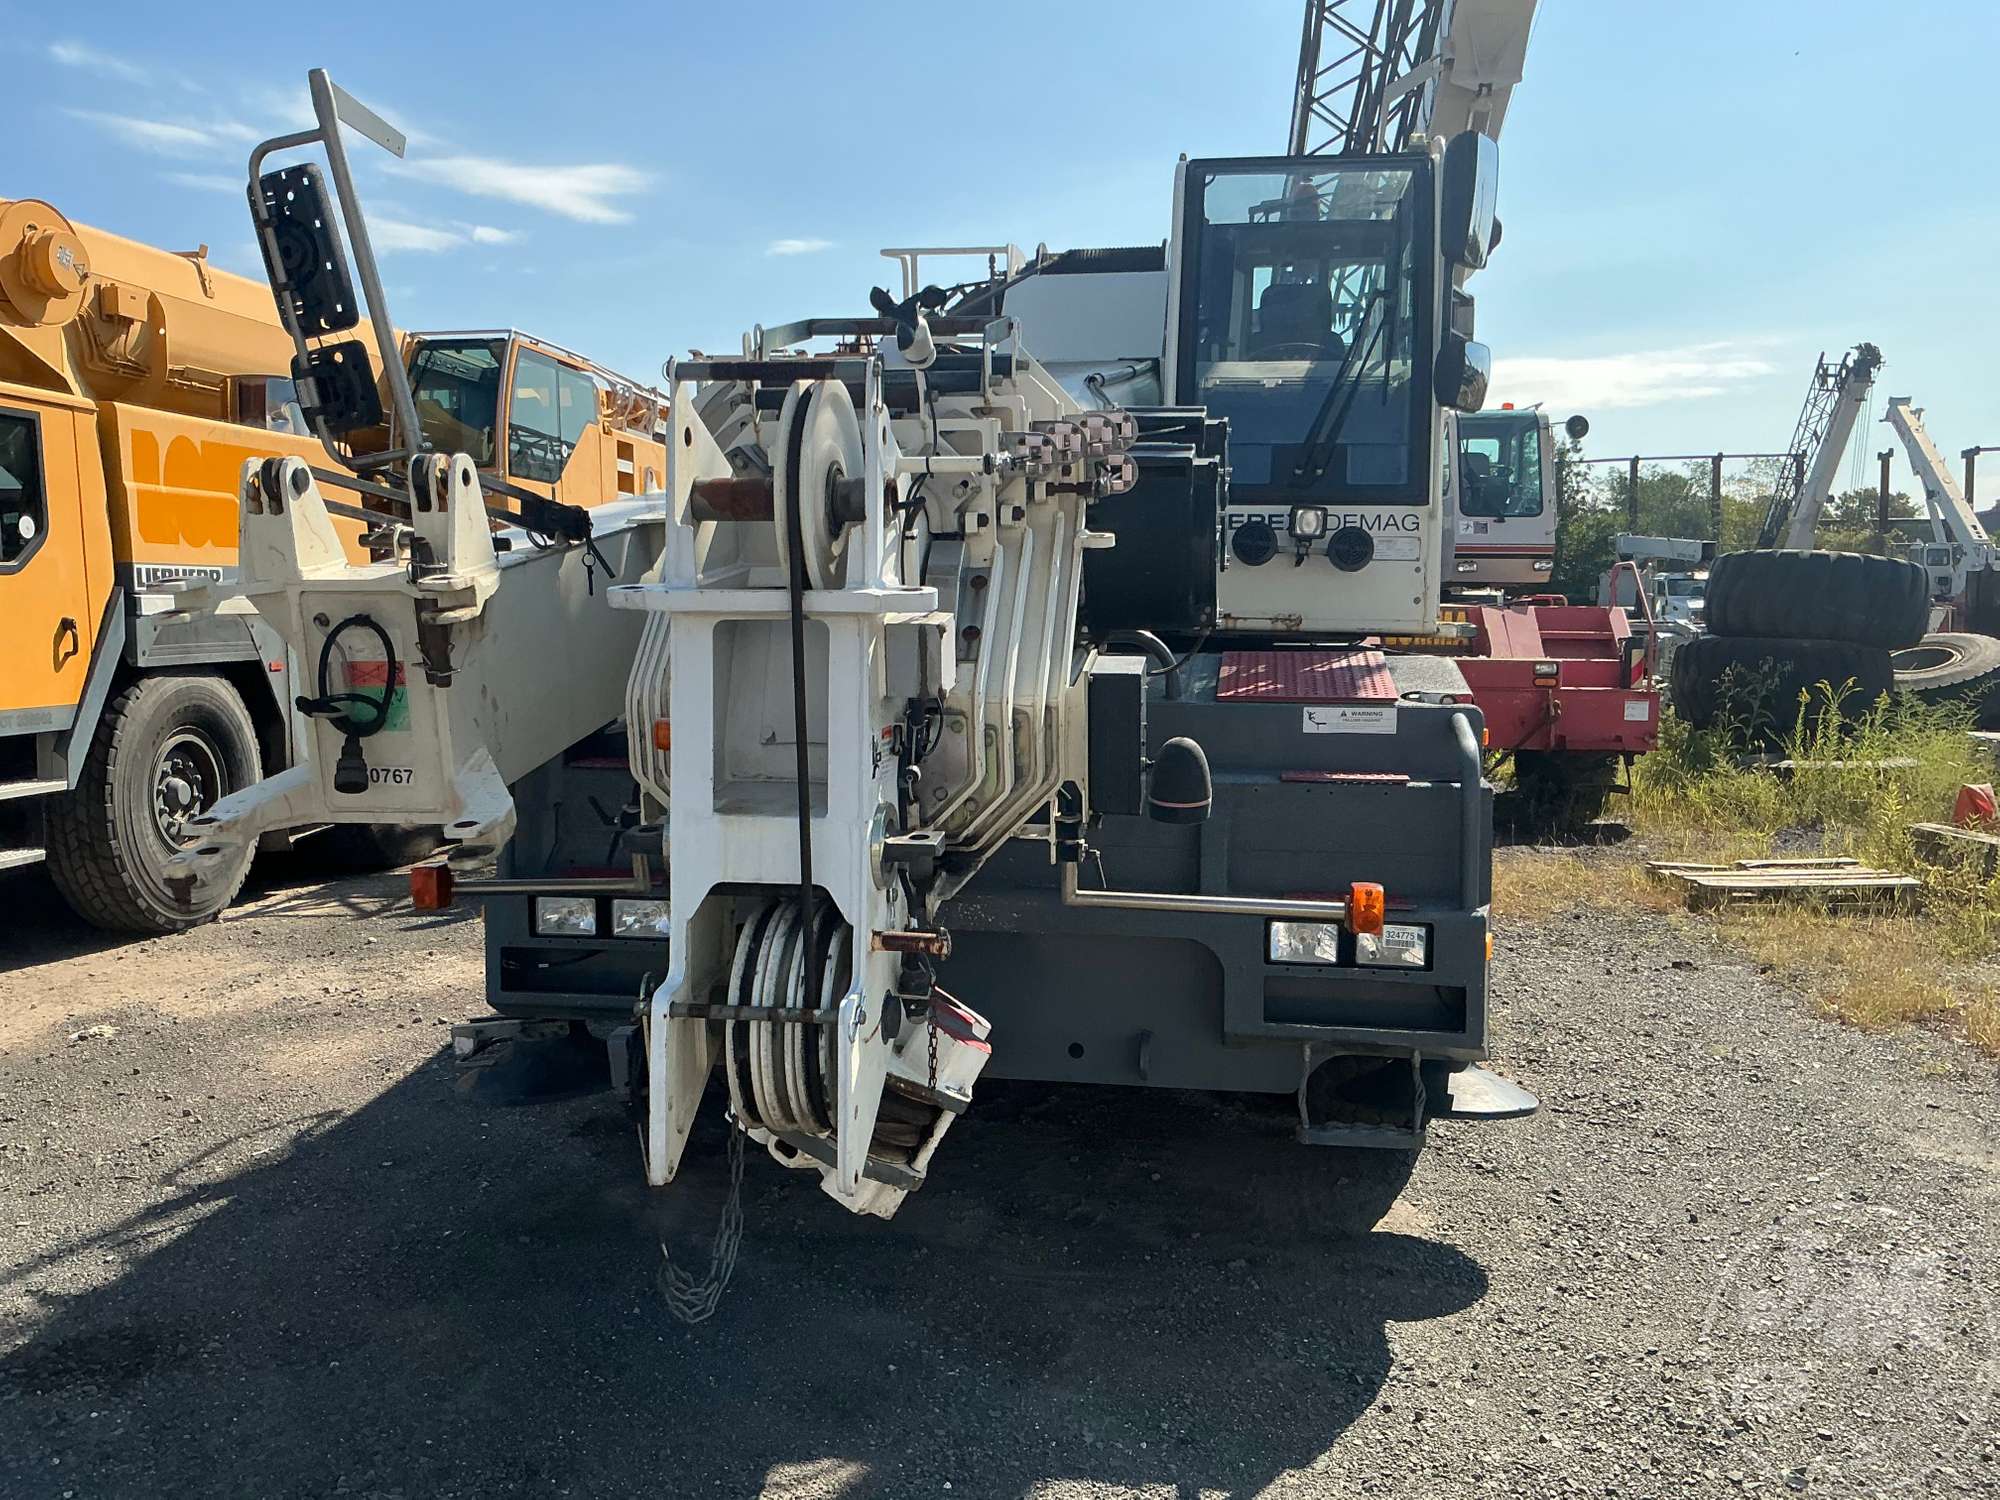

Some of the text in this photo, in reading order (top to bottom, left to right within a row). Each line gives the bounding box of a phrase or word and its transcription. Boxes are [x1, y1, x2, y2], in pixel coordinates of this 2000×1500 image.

[1323, 513, 1420, 532] DEMAG
[370, 767, 413, 784] 0767
[1385, 930, 1415, 941] 324775
